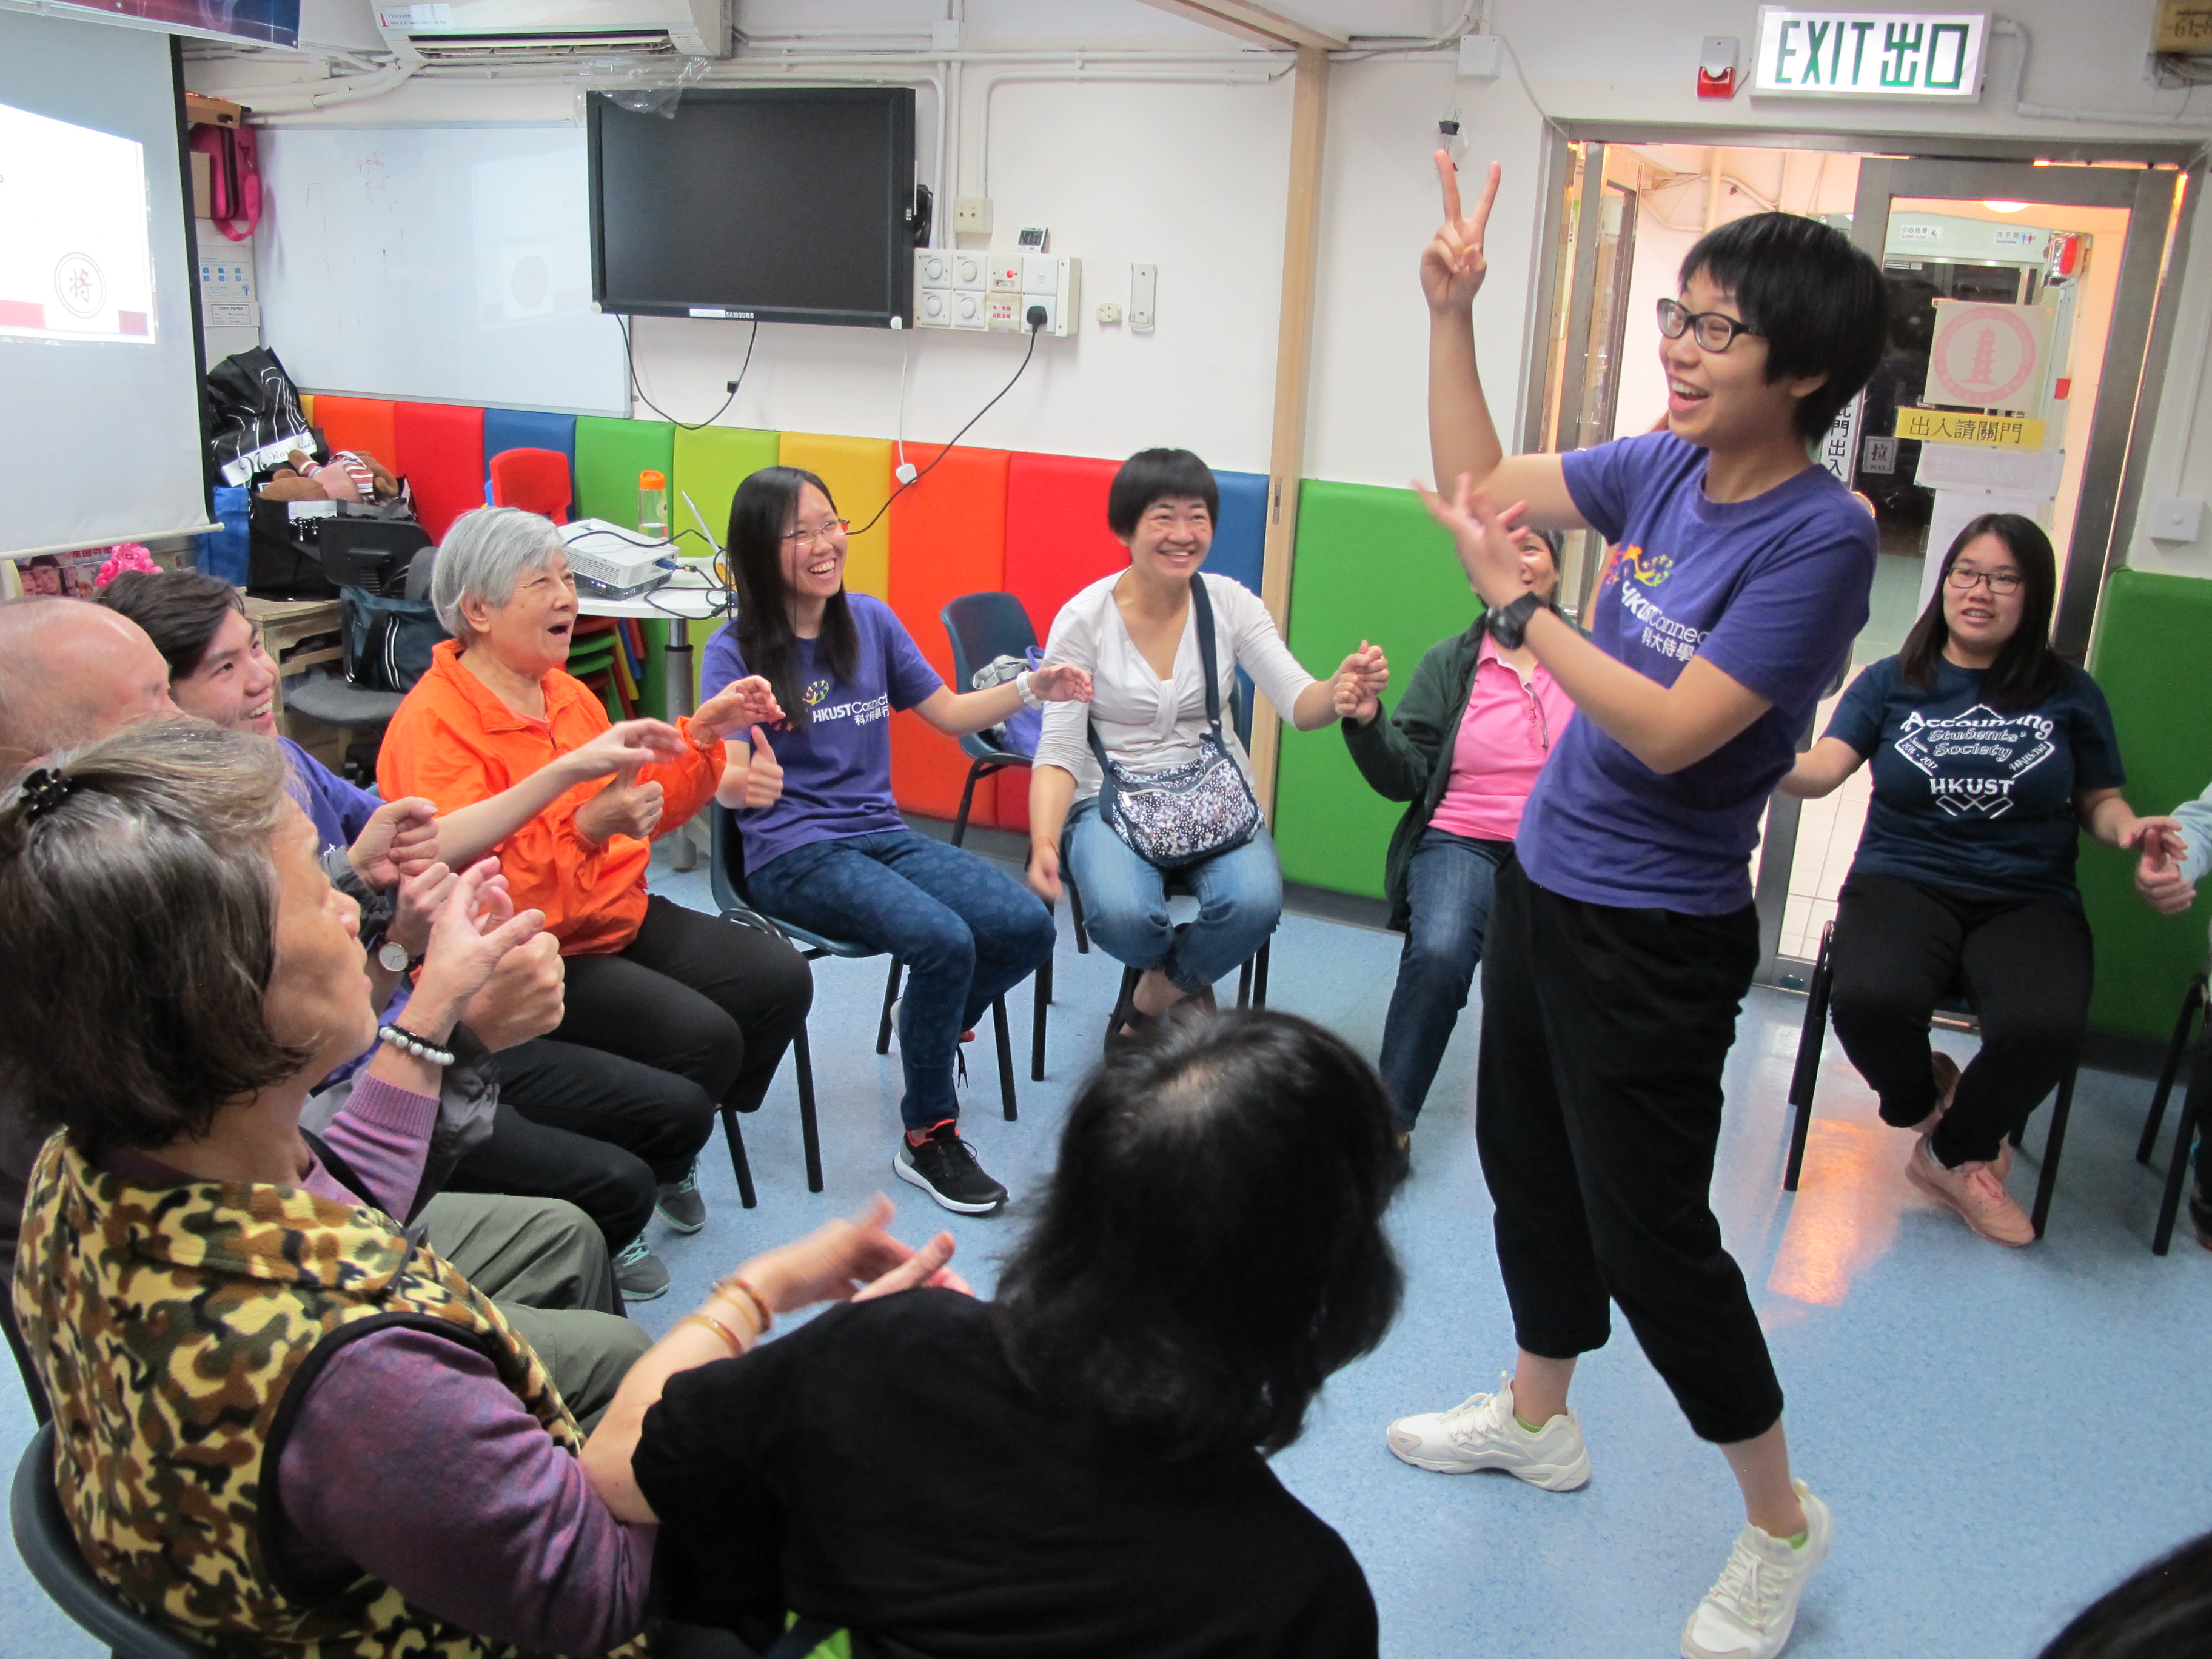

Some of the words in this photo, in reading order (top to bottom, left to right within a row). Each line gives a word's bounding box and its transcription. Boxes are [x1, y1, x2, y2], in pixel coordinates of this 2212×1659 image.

[1775, 21, 1875, 85] EXIT
[1880, 22, 1969, 89] 出口
[1909, 416, 2023, 444] 出入請關門
[1871, 444, 1887, 461] 拉
[1933, 743, 2013, 762] Society
[1920, 756, 1938, 769] 2017
[1929, 778, 2014, 795] HKUST
